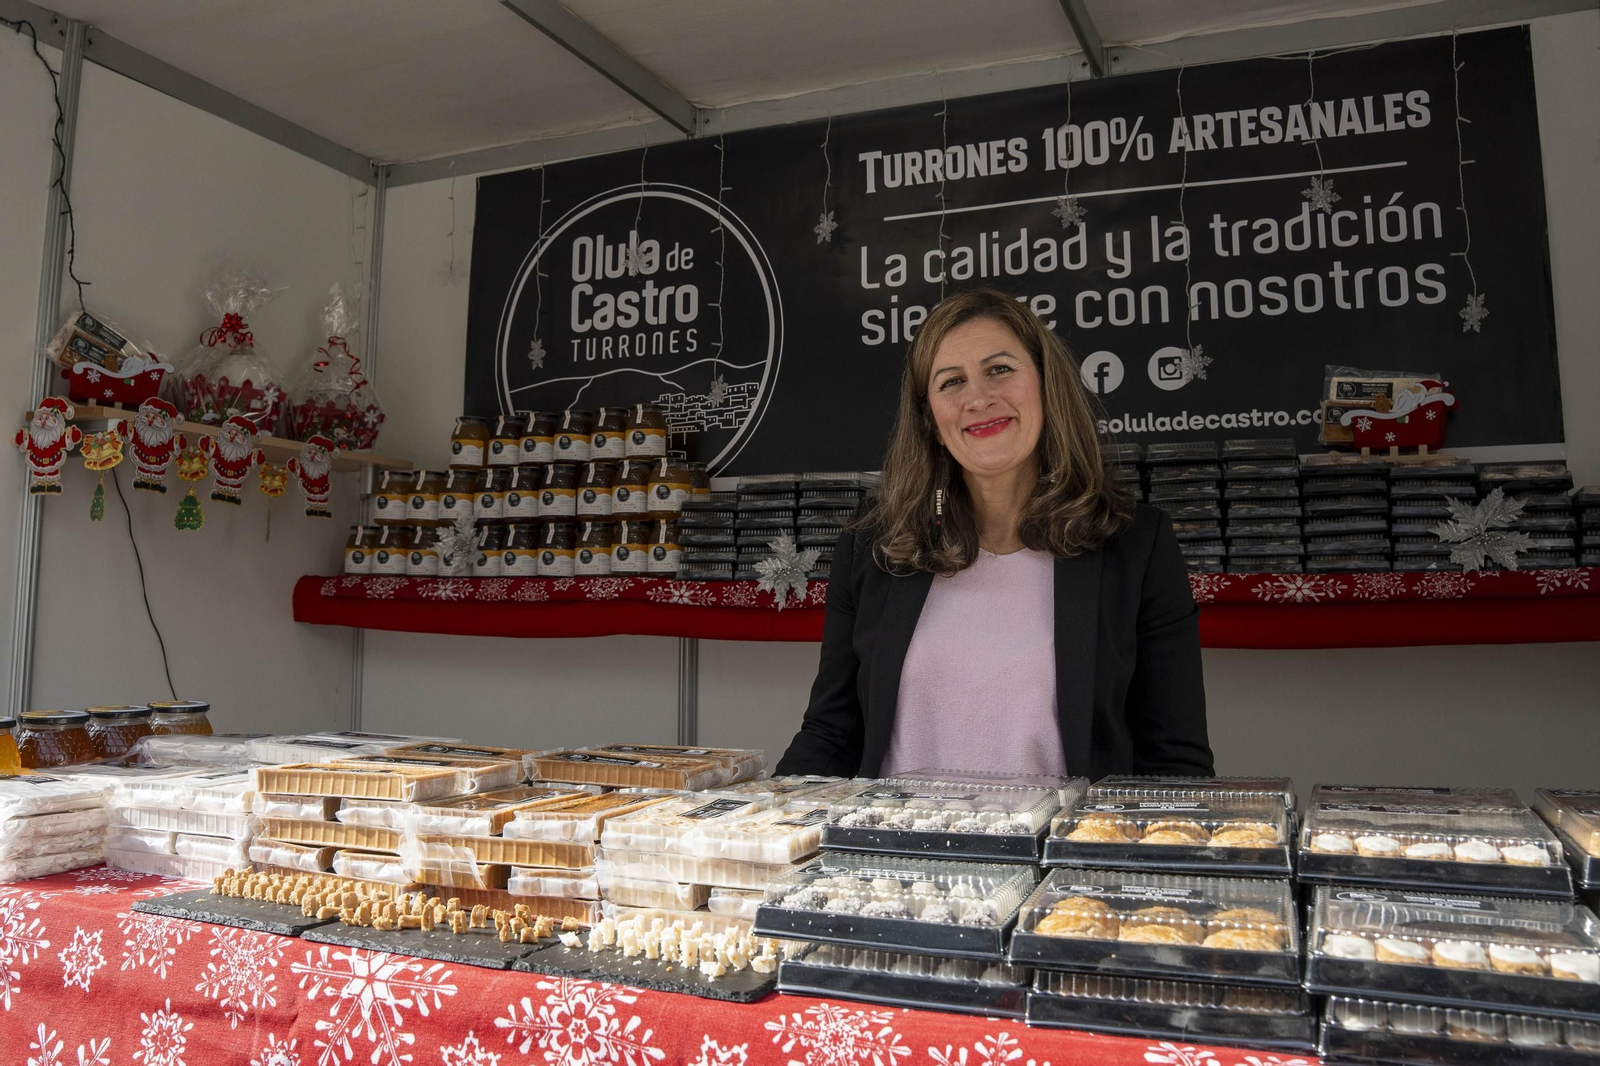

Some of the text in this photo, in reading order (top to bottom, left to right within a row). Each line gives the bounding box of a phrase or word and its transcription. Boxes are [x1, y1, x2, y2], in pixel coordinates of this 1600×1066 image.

[1041, 115, 1154, 171] 100%
[1168, 89, 1431, 154] ARTESANALES
[572, 229, 694, 283] Olula de
[860, 191, 1443, 290] La calidad y la tradición
[571, 279, 699, 333] Castro
[861, 261, 1447, 346] siee con nosotros
[571, 328, 698, 362] TURRONES
